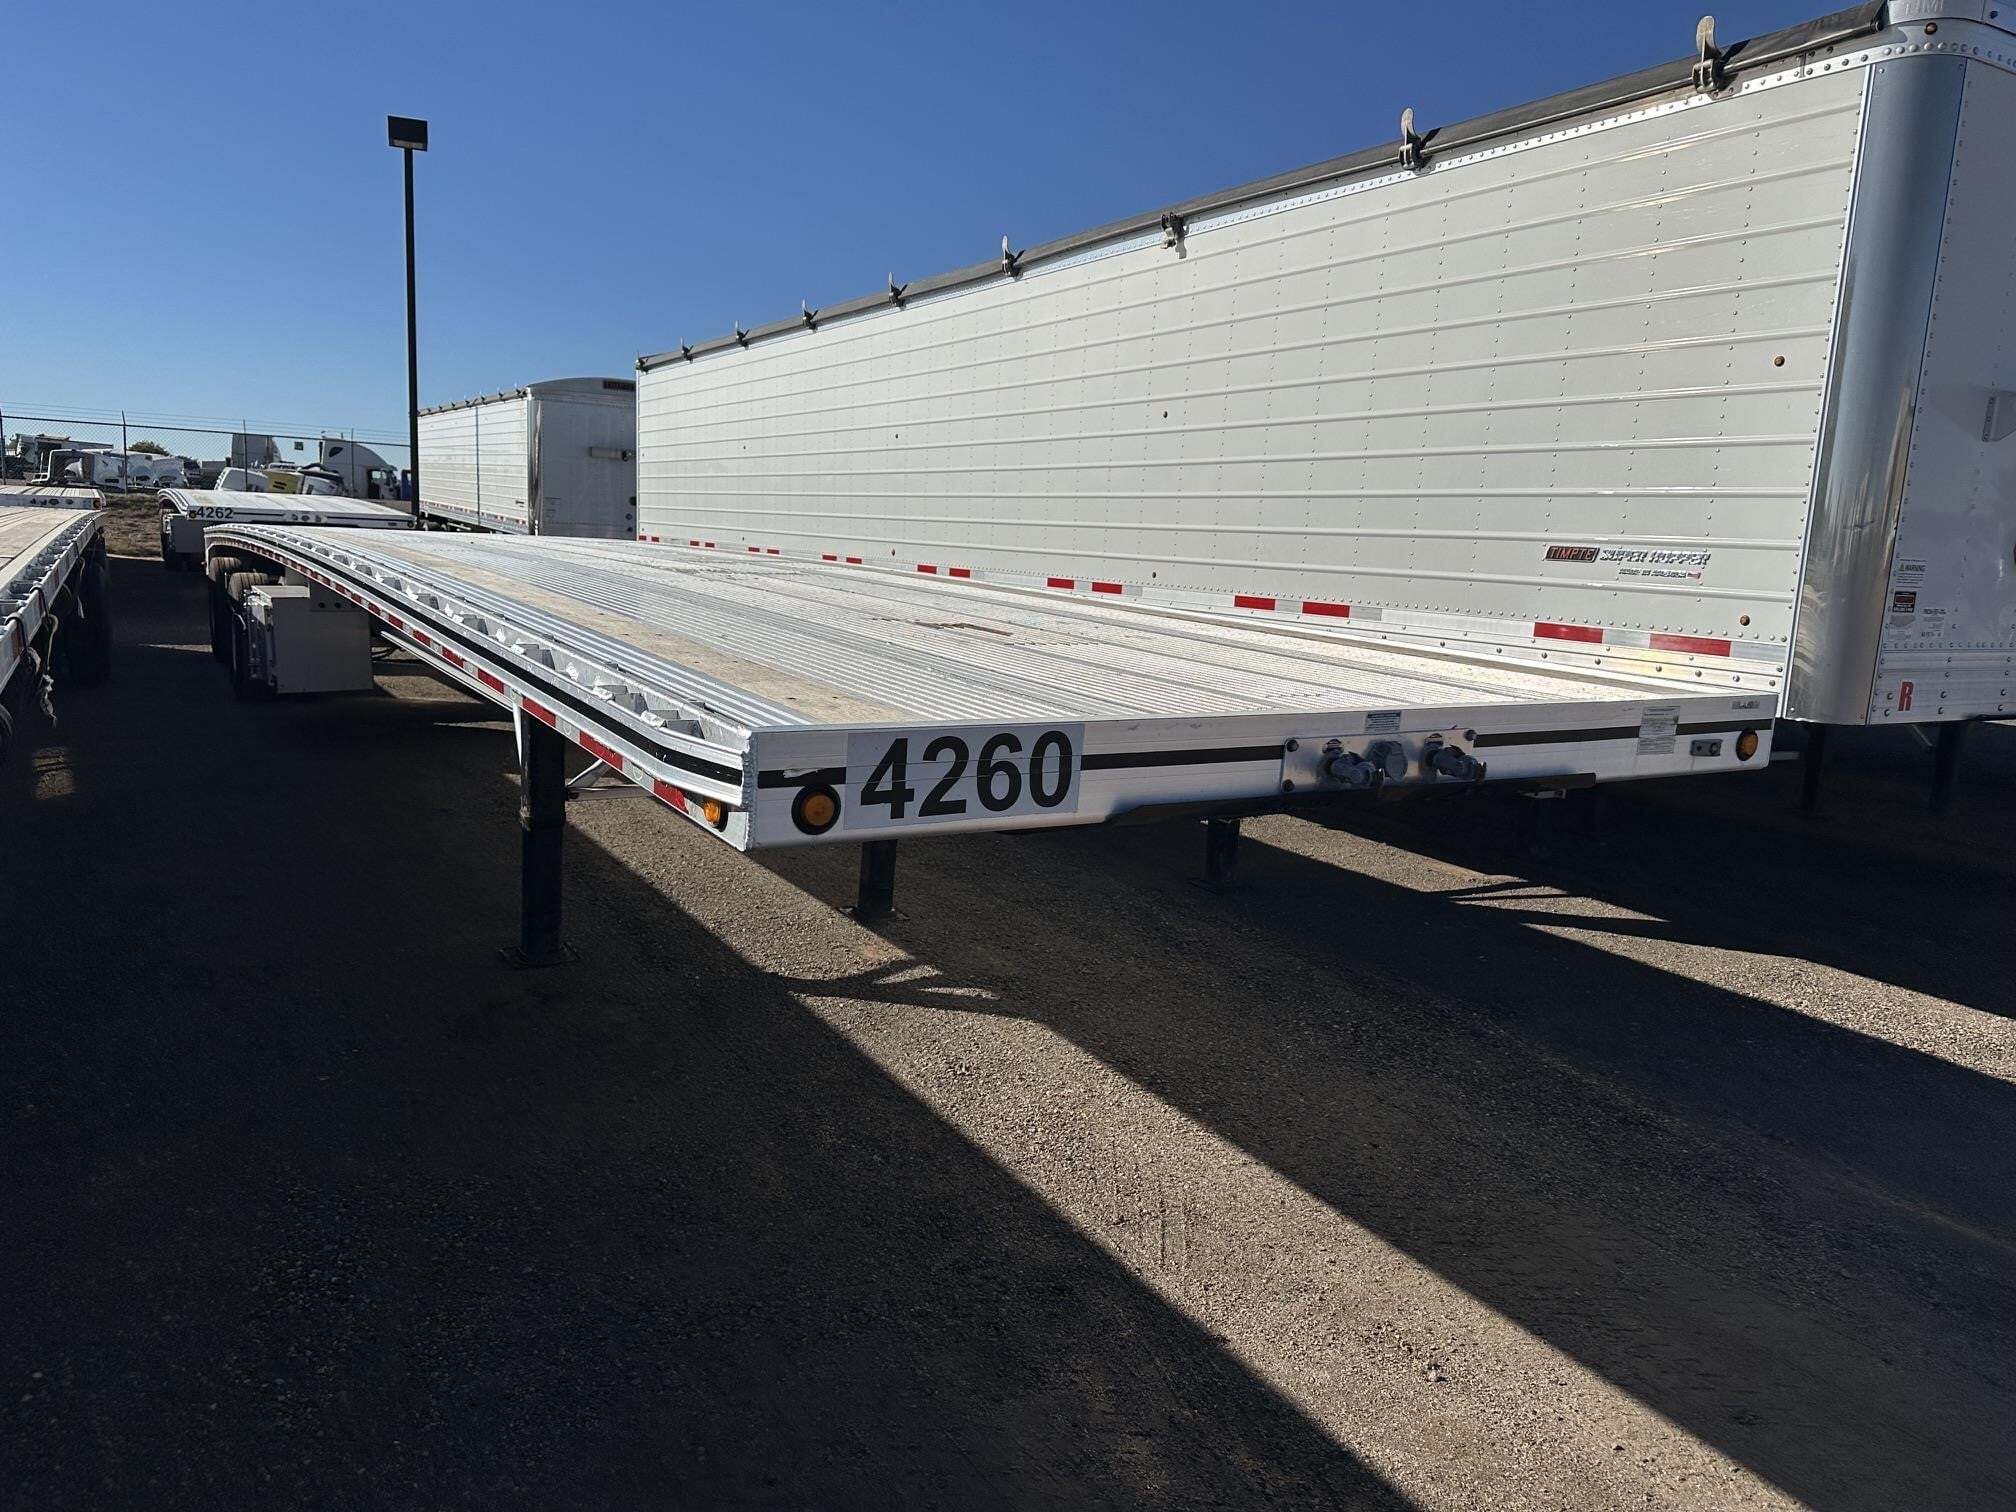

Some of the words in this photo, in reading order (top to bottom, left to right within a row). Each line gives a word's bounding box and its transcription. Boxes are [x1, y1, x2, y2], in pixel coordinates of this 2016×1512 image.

[196, 506, 234, 519] 4262
[1549, 547, 1596, 560] TIMPTE
[1898, 681, 1914, 711] R
[860, 730, 1073, 820] 4260
